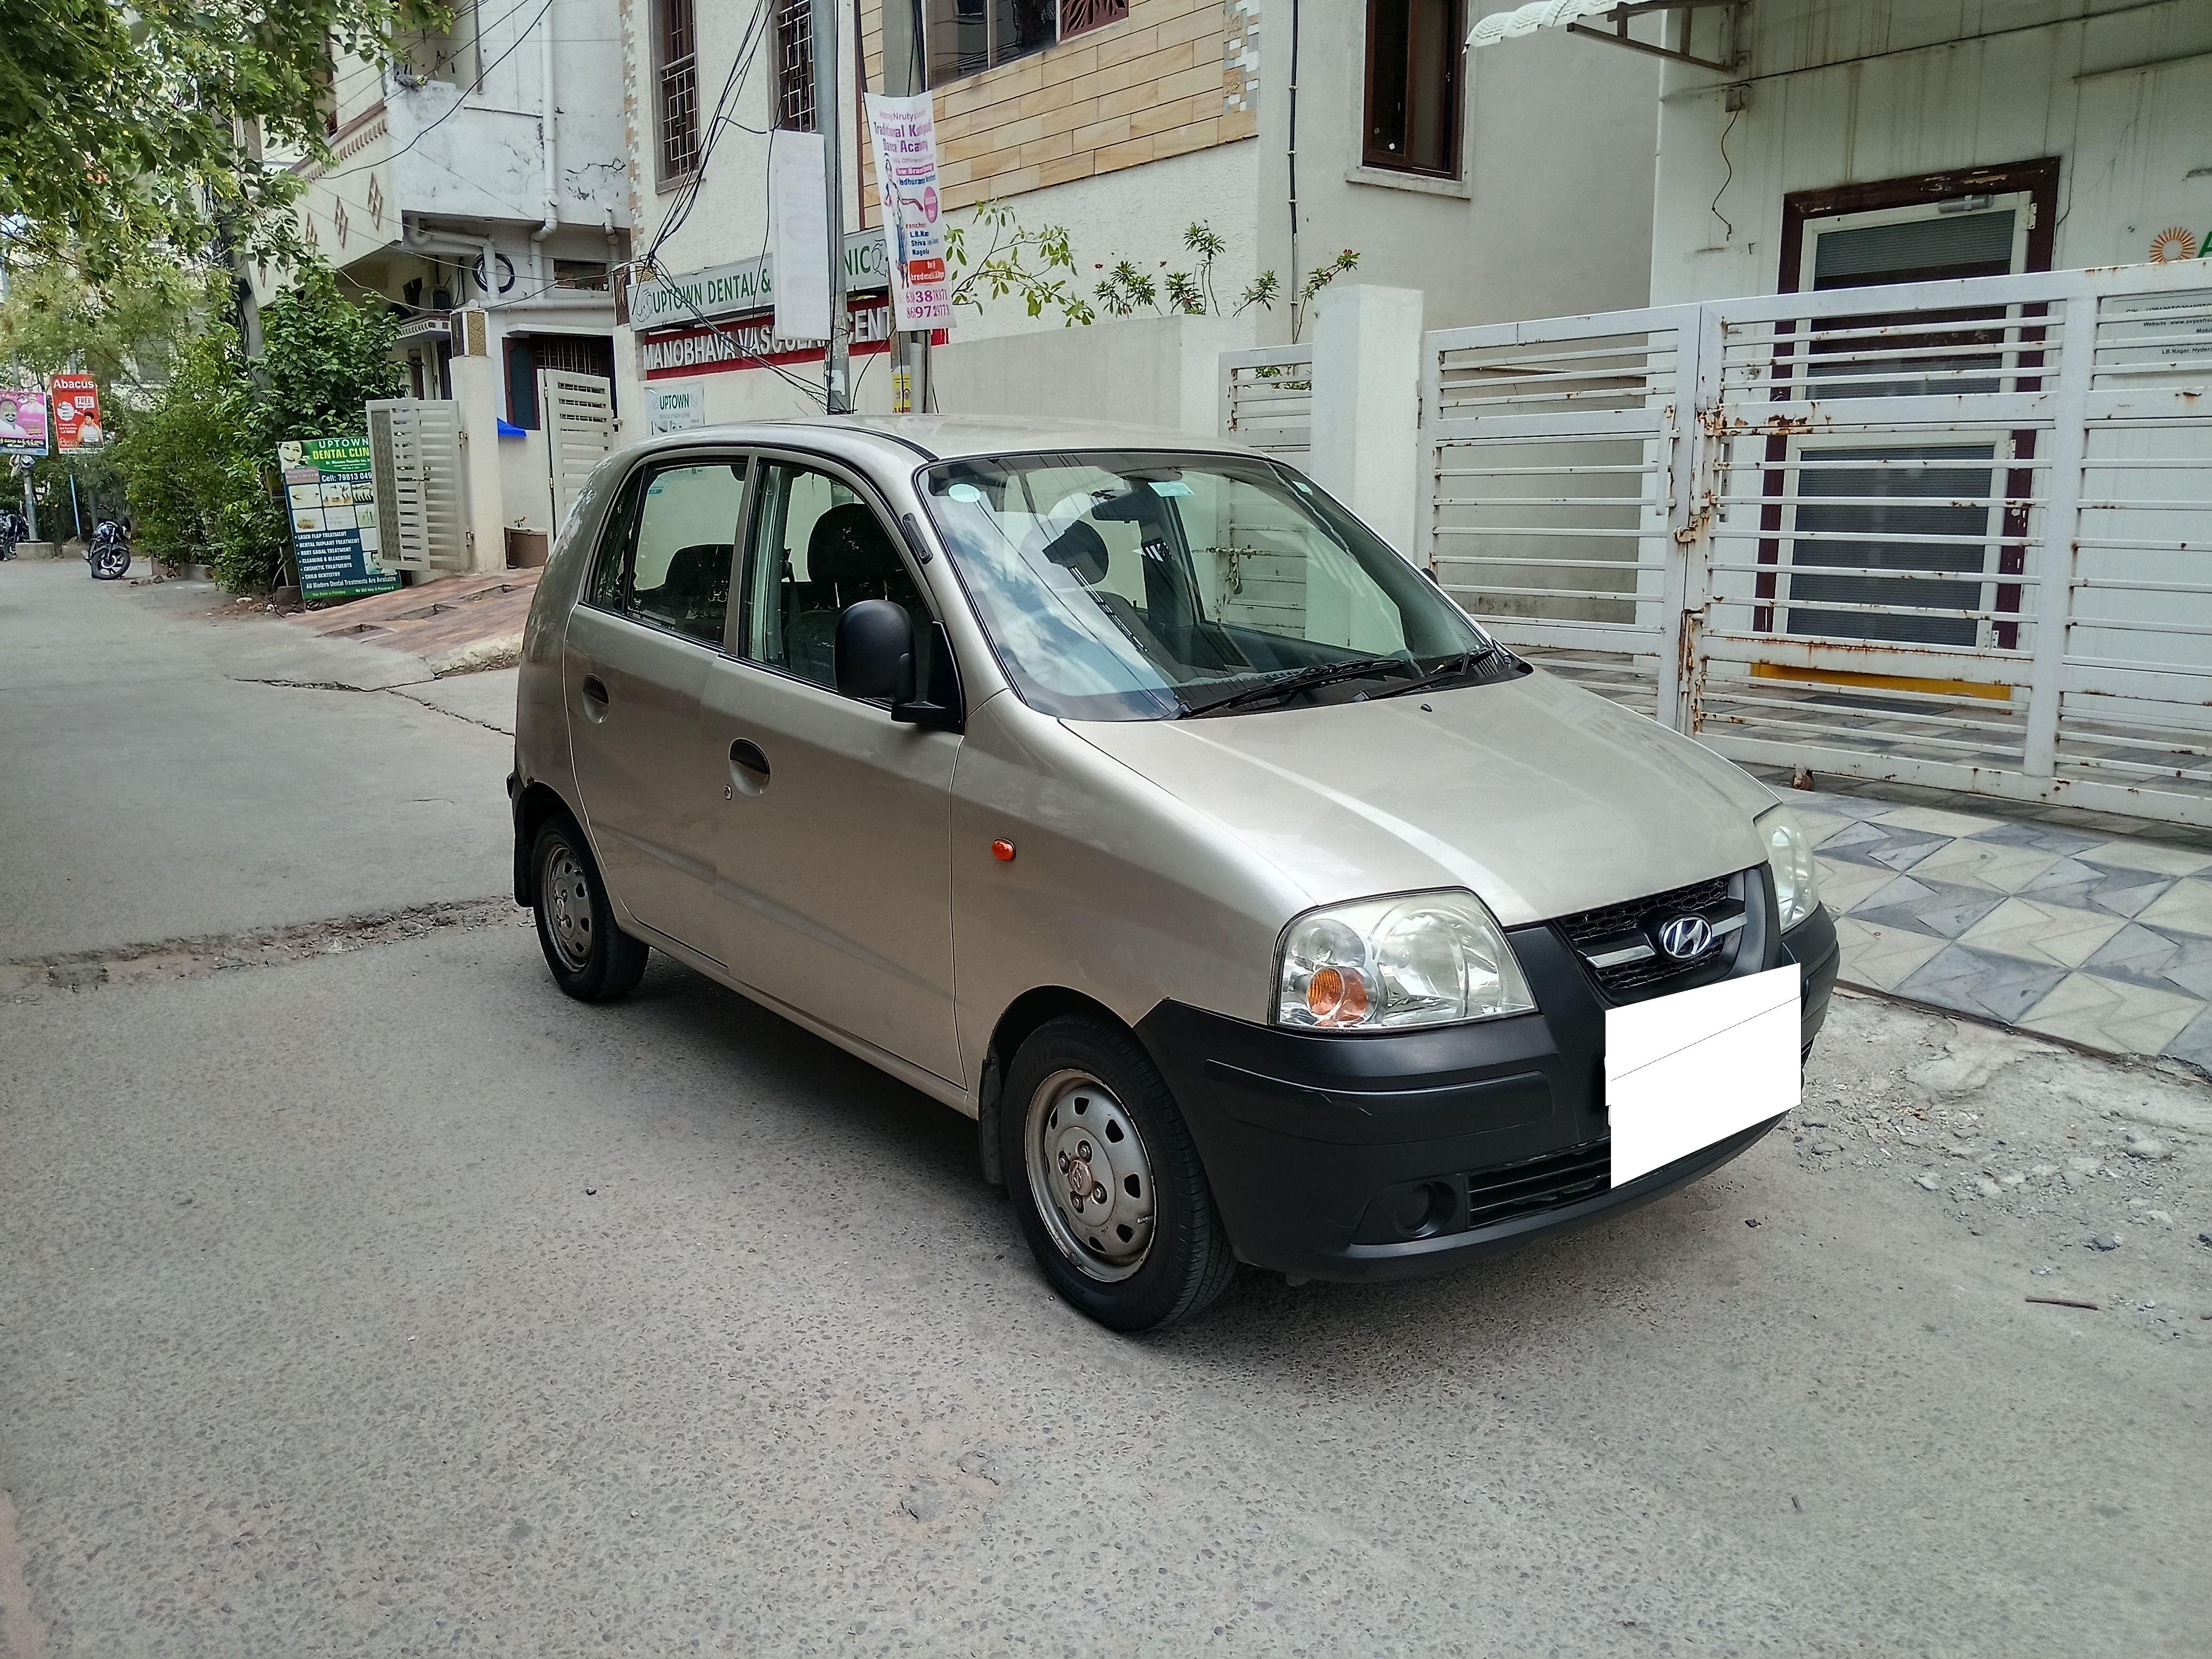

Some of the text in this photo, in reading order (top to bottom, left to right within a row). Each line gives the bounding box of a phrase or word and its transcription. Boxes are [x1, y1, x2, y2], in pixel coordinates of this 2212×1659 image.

[652, 282, 703, 314] UPTOWN
[708, 272, 756, 304] DENTAL
[761, 268, 771, 294] &
[643, 331, 736, 370] MANOBHAVA
[53, 379, 95, 389] Abacus
[660, 394, 689, 410] UPTOWN
[319, 437, 369, 449] UPTOWN
[312, 449, 347, 460] DENTAL
[338, 473, 359, 481] 79813
